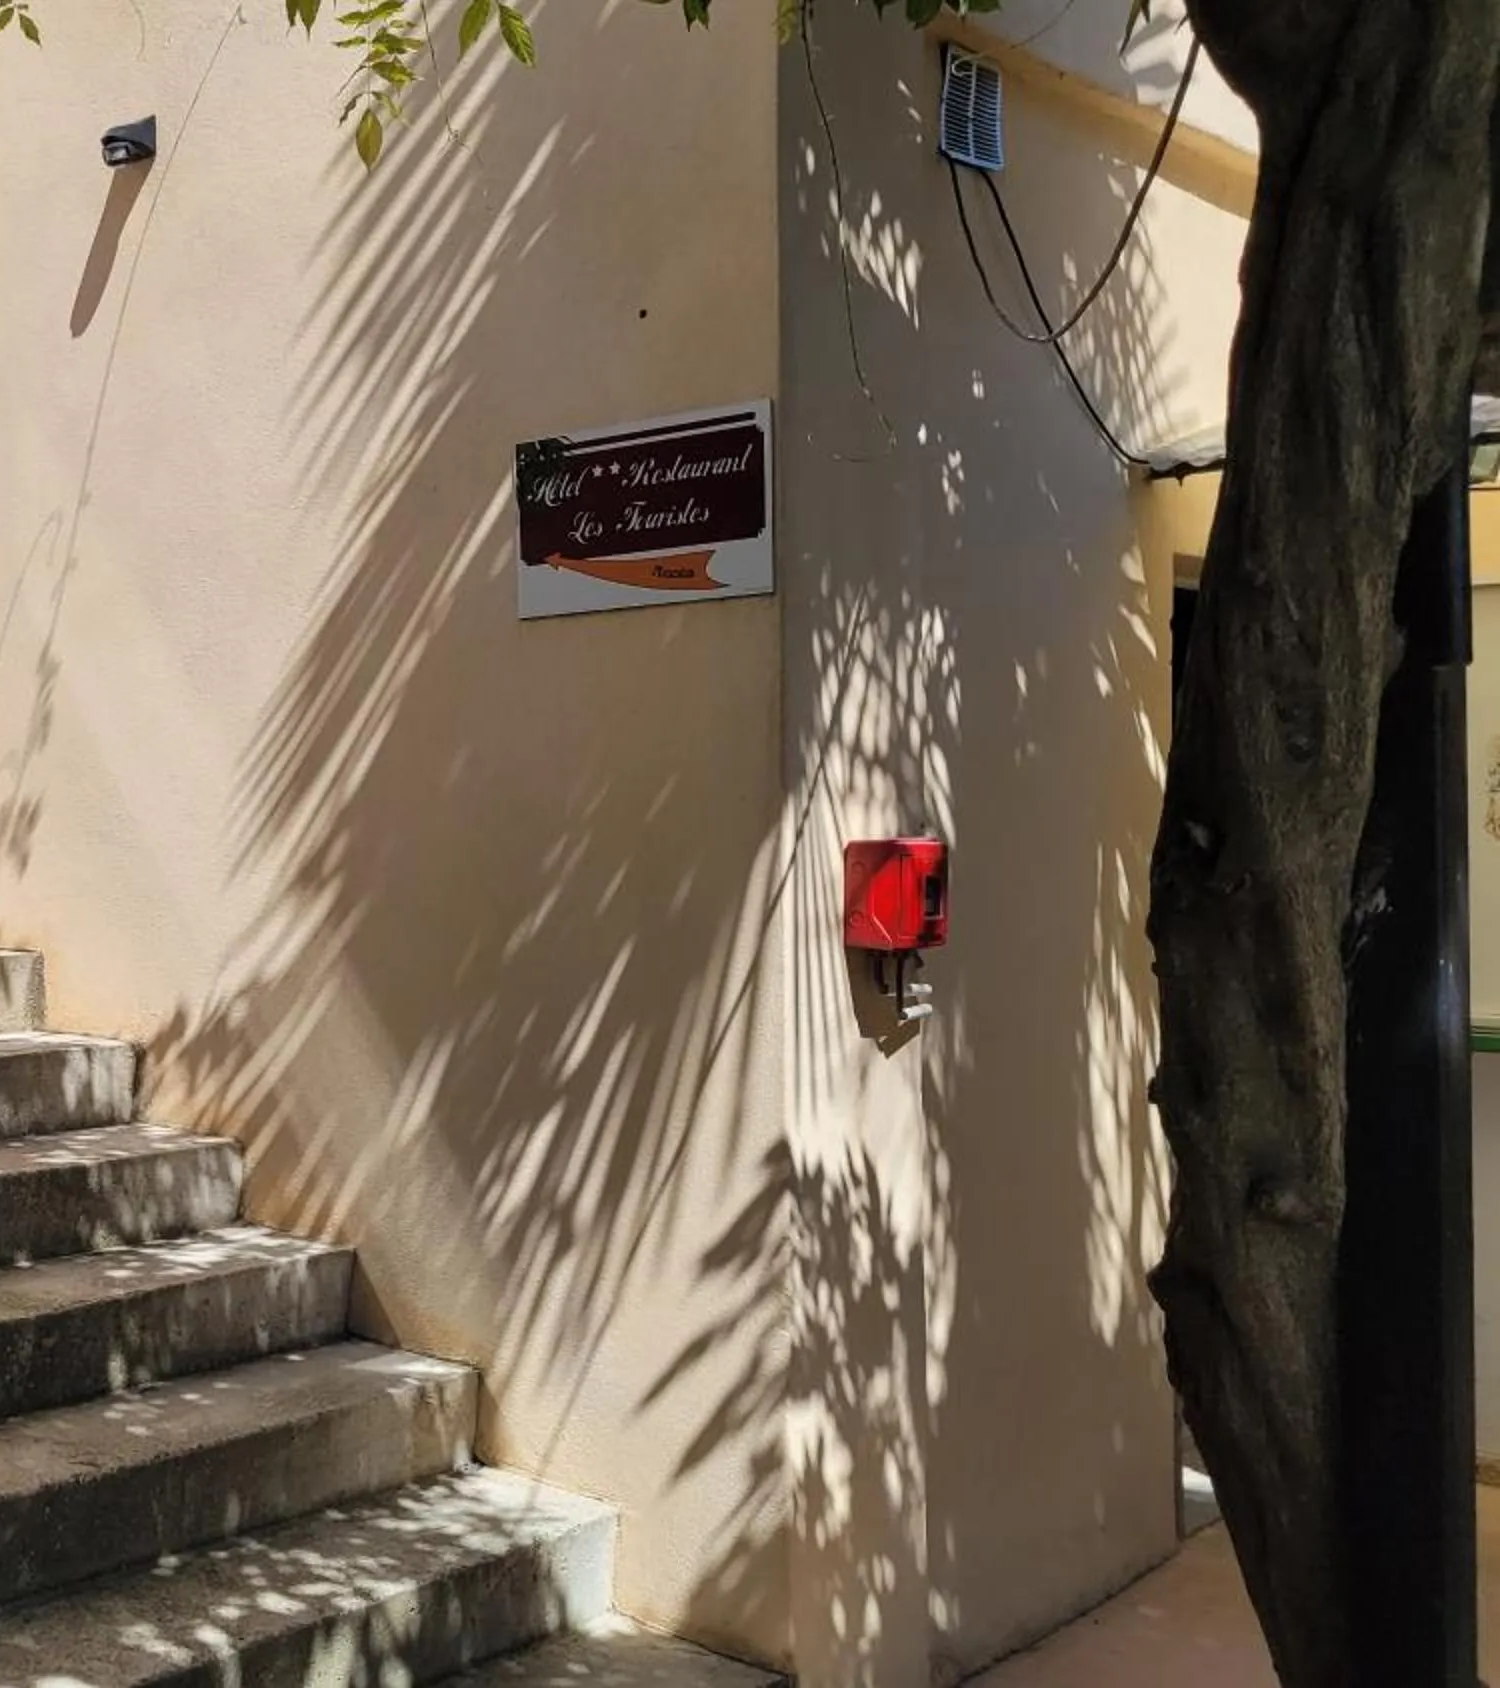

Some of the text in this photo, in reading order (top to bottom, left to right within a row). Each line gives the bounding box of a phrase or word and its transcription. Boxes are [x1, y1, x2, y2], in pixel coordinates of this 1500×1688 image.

[621, 443, 753, 488] Restaurant
[567, 497, 710, 545] Les Touristes
